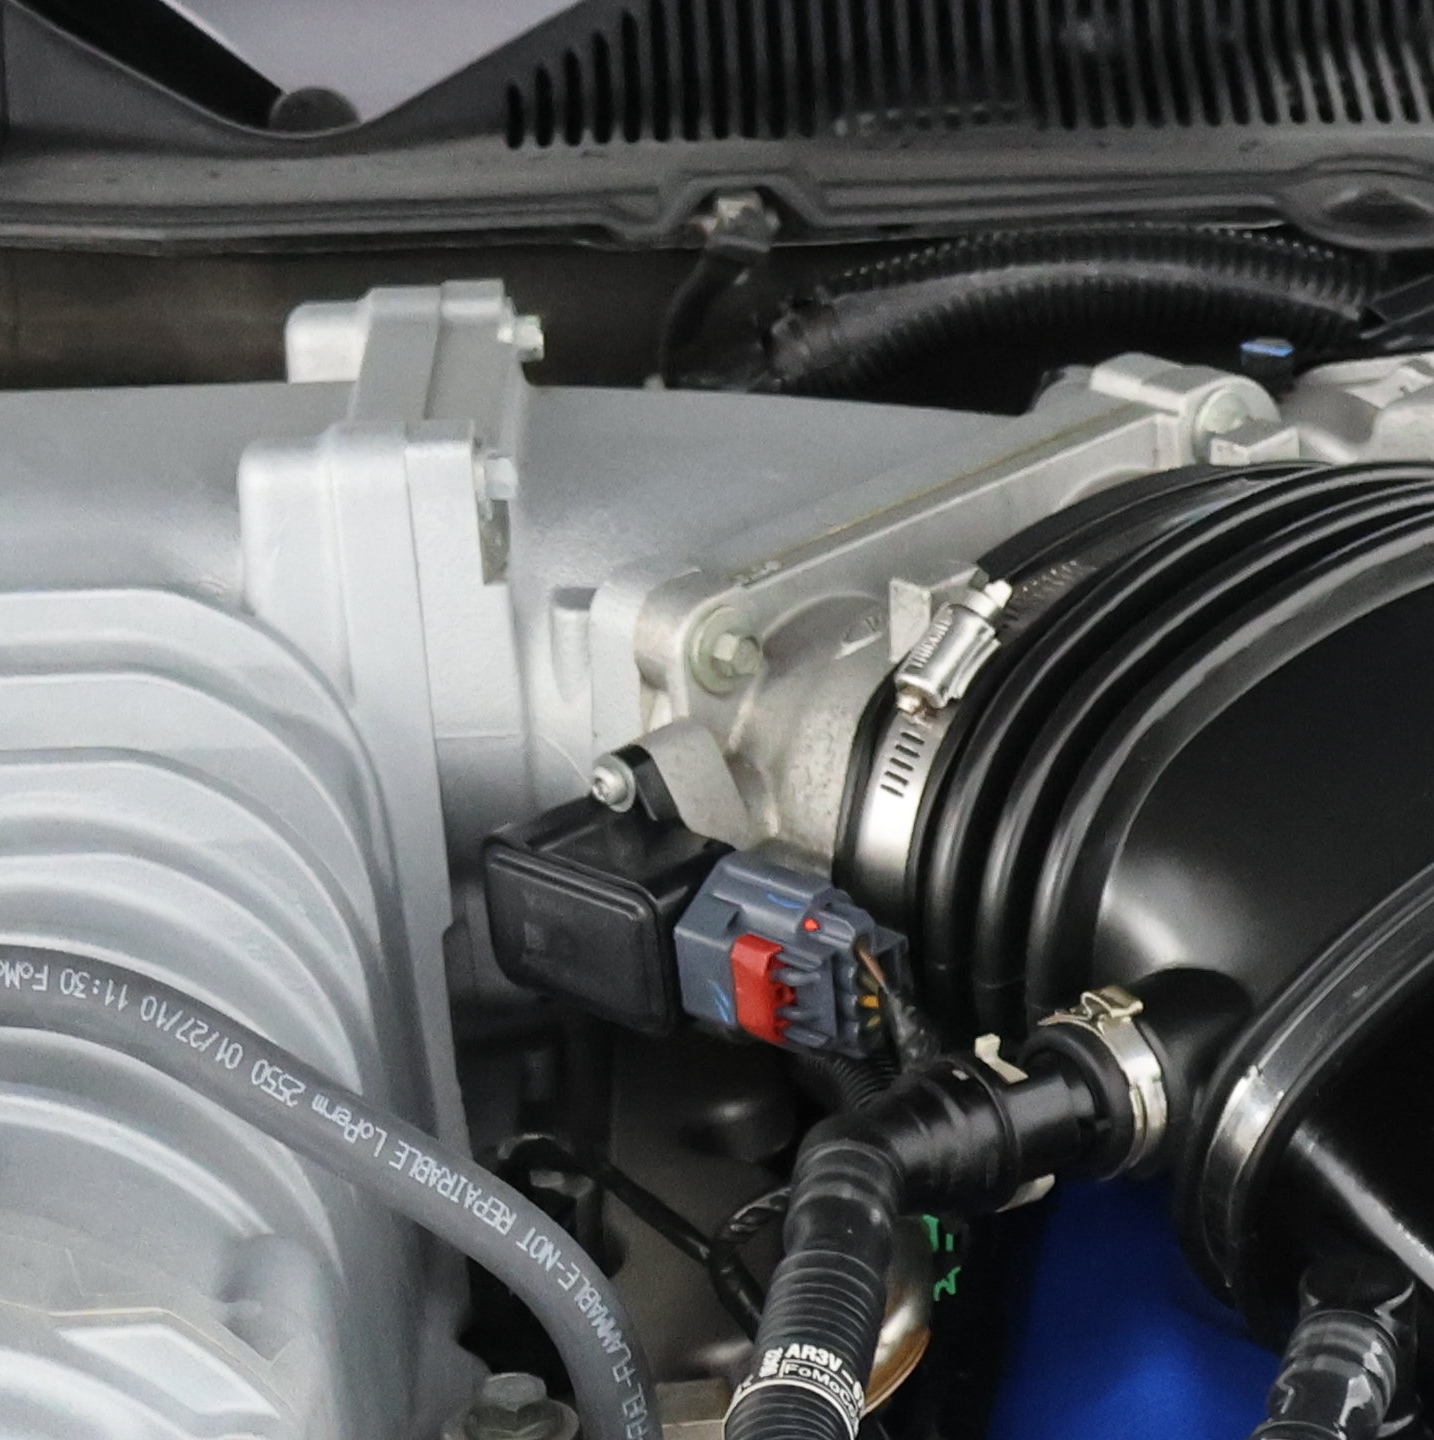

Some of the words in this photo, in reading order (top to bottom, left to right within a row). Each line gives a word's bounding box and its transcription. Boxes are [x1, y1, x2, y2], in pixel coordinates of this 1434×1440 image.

[60, 968, 128, 1011] 11:30
[140, 995, 243, 1070] 01/27/10
[251, 1059, 306, 1107] 2550
